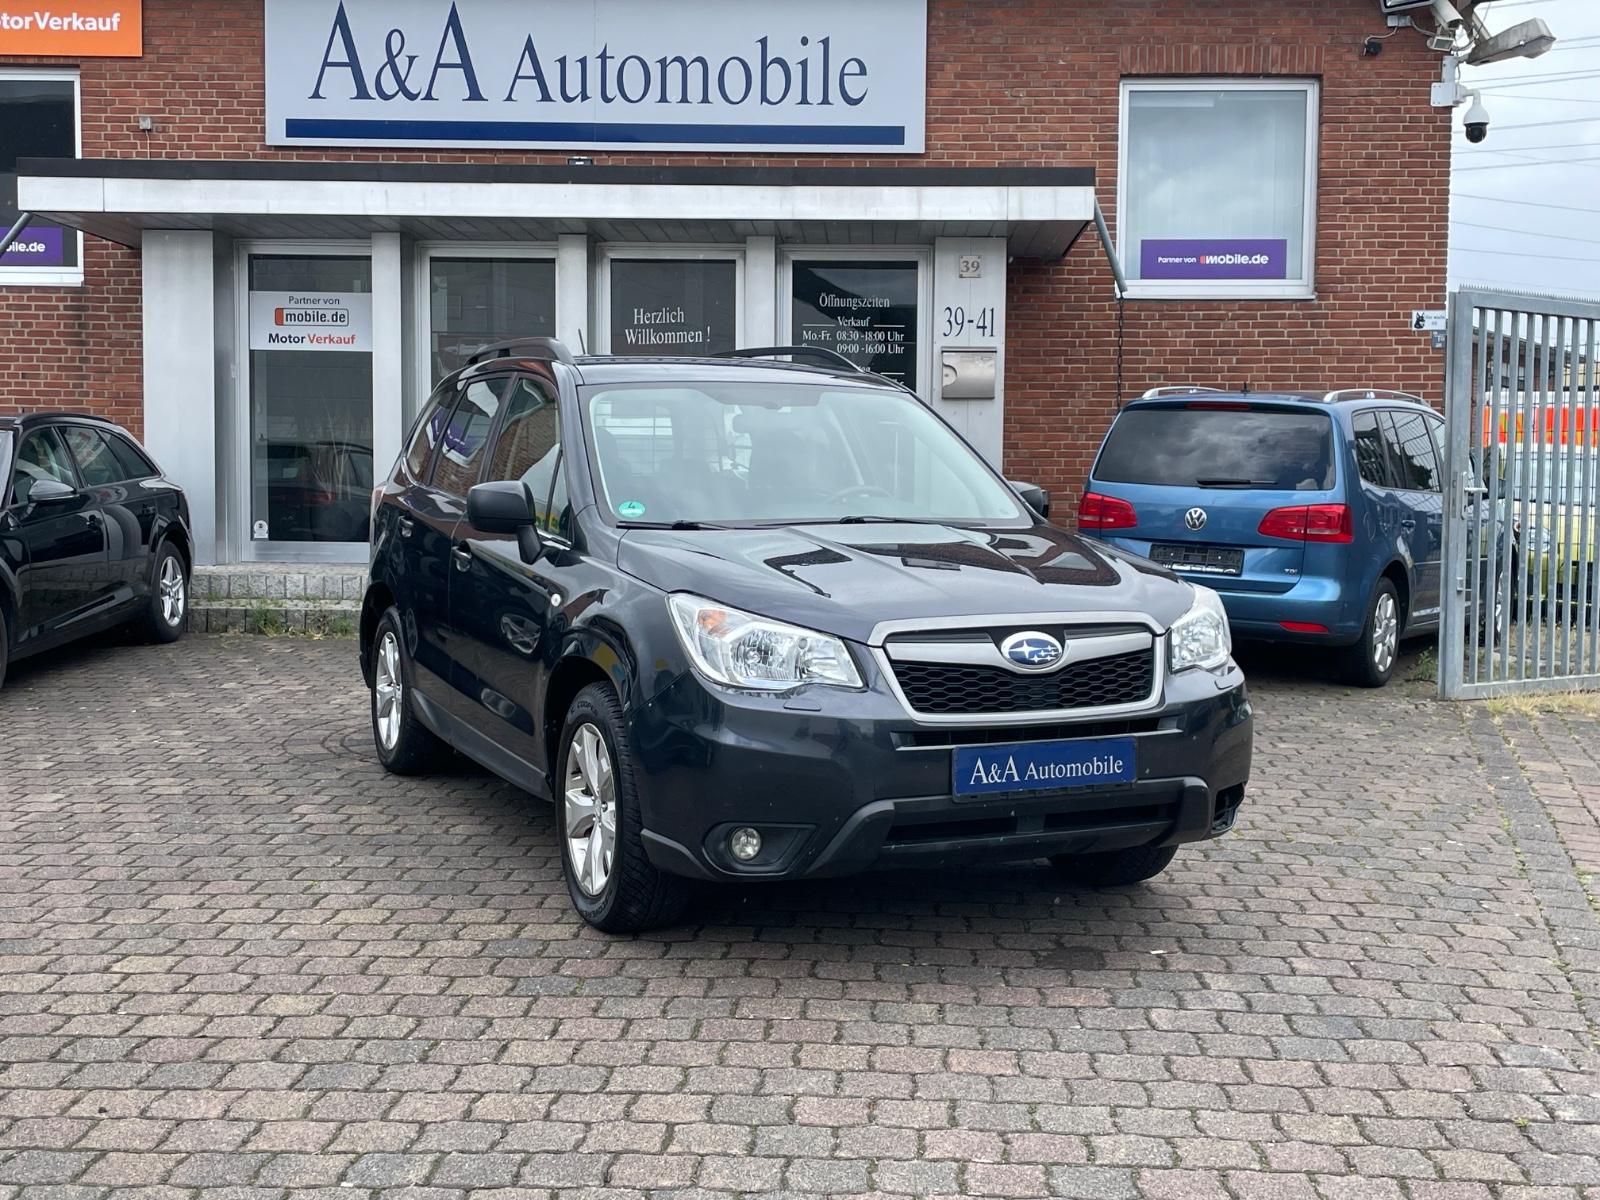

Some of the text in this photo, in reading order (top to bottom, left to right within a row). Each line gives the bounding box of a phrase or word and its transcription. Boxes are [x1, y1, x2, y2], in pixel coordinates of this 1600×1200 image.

[0, 11, 121, 31] torVerkauf
[308, 0, 869, 106] A&A Automobile
[1157, 256, 1183, 264] Partner
[1205, 253, 1269, 265] mobile.de
[960, 260, 980, 273] 39
[288, 295, 340, 305] Partner von
[819, 292, 890, 310] Öffnungszeiten
[285, 310, 346, 323] mobile.de
[633, 306, 685, 325] Herzlich
[837, 316, 871, 327] Verkauf
[942, 306, 995, 337] 39-41
[802, 330, 832, 340] Mo.-Fr.
[836, 330, 859, 341] 08:30
[887, 331, 905, 341] Uhr
[836, 343, 859, 354] 09:00
[887, 343, 905, 354] Uhr
[969, 755, 1124, 785] A&A Automobile
